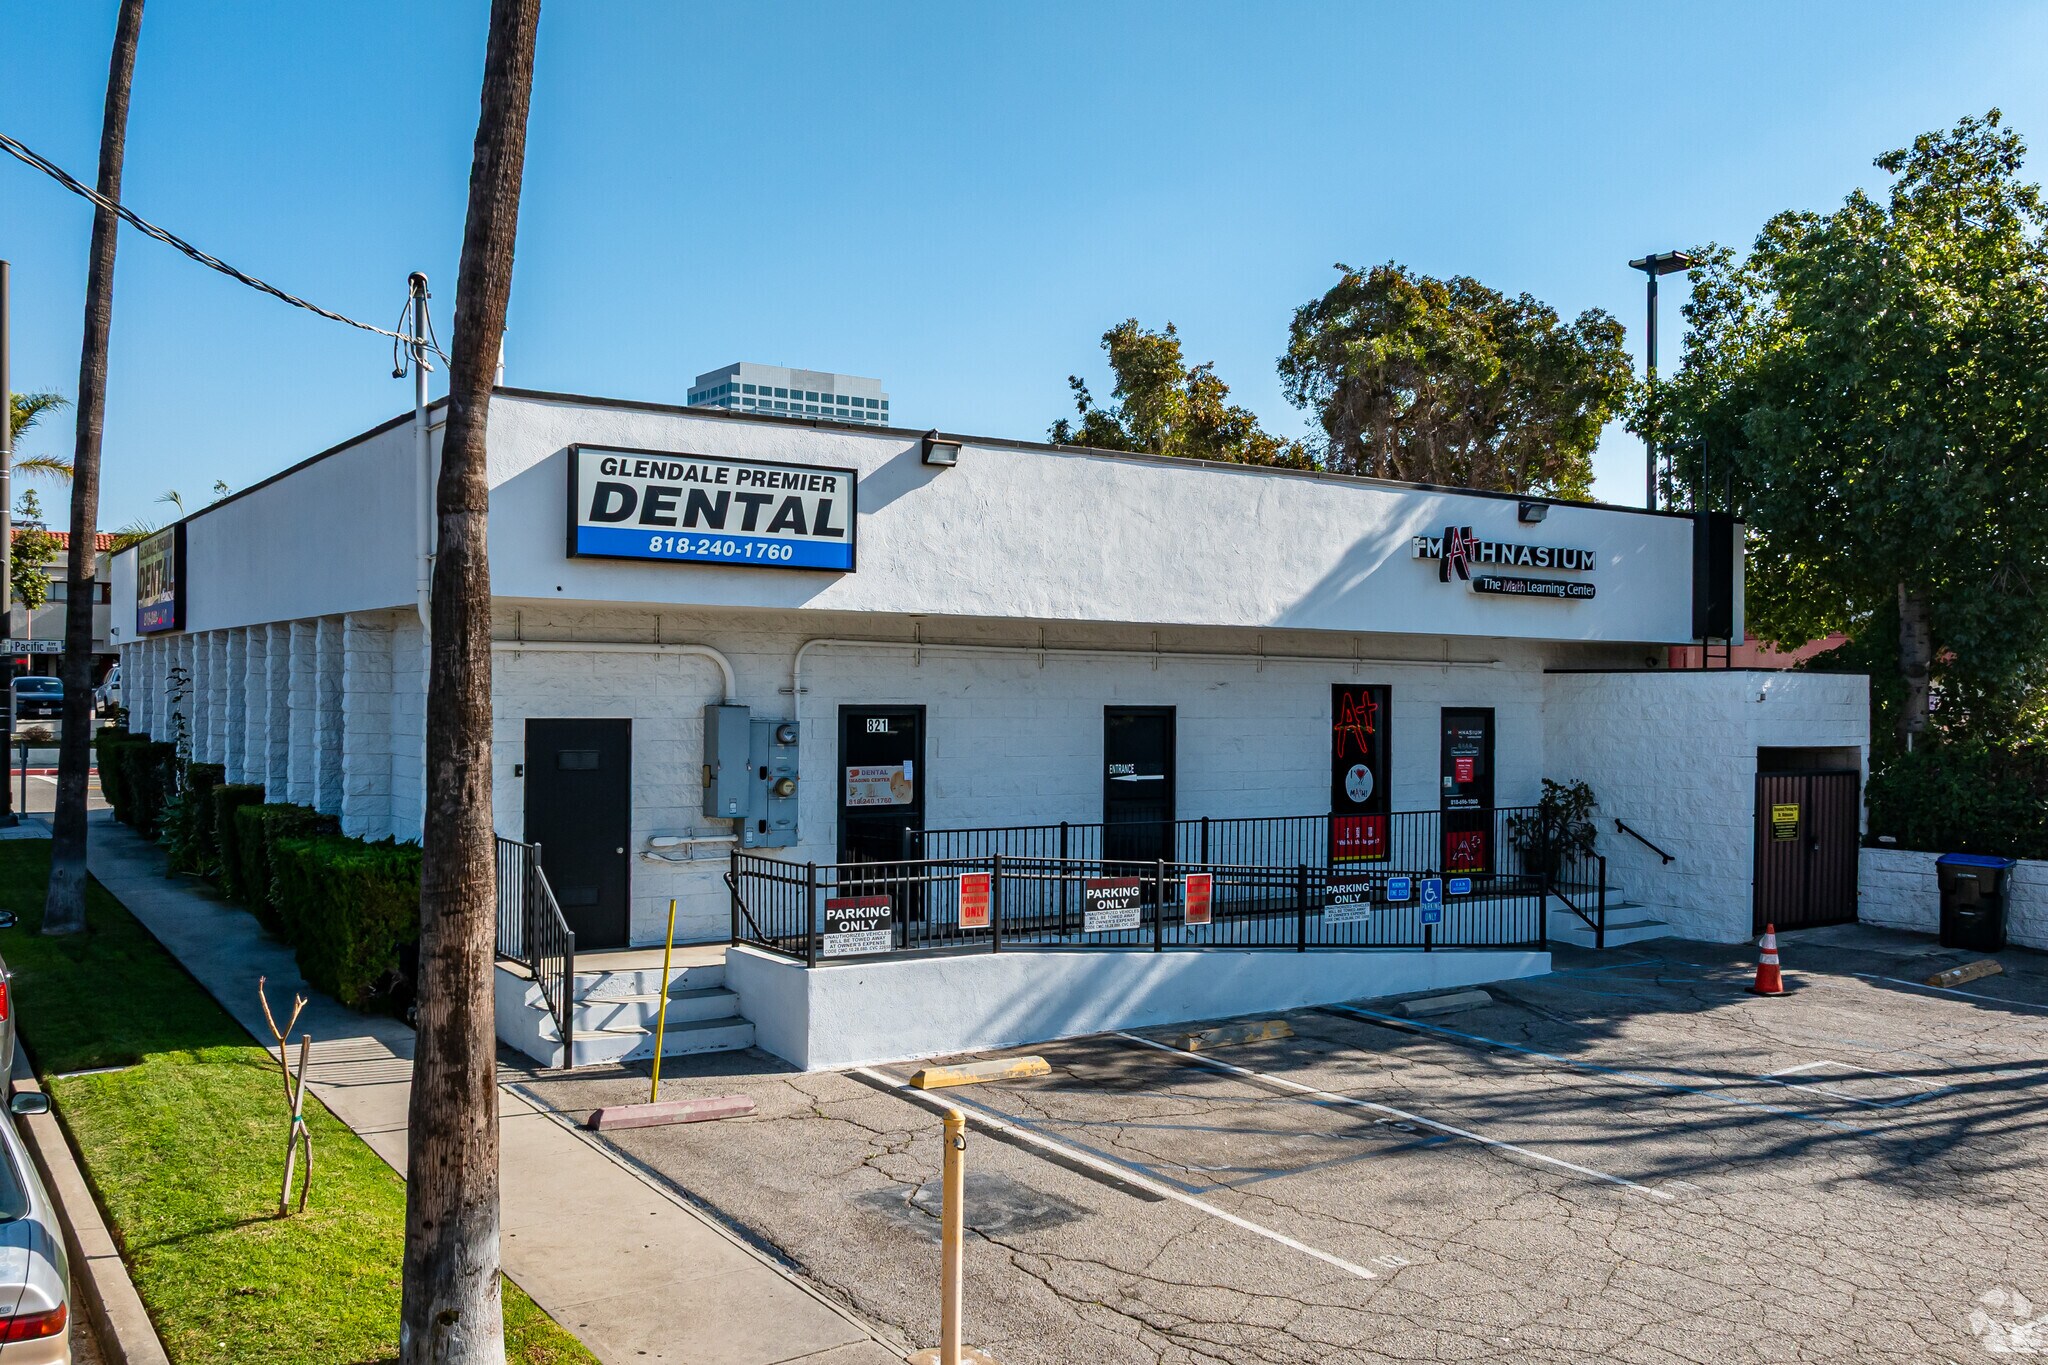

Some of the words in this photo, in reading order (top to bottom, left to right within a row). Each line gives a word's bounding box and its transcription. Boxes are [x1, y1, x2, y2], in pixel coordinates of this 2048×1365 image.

[600, 458, 729, 485] GLENDALE
[736, 468, 836, 493] PREMIER
[589, 481, 844, 537] DENTAL
[649, 536, 792, 560] 818-240-1760
[1484, 578, 1501, 590] The
[1503, 580, 1525, 593] Math
[1528, 581, 1565, 597] Learning
[1567, 583, 1594, 596] Center
[15, 642, 44, 651] Pacific
[868, 720, 887, 731] 821
[1109, 764, 1134, 774] ENTRANCE
[1087, 887, 1139, 899] PARKING
[1326, 883, 1369, 894] PARKING
[1097, 899, 1129, 909] ONLY
[1335, 894, 1361, 903] ONLY
[827, 906, 890, 920] PARKING
[965, 906, 985, 917] ONLY
[1425, 912, 1437, 921] ONLY
[839, 920, 878, 932] ONLY
